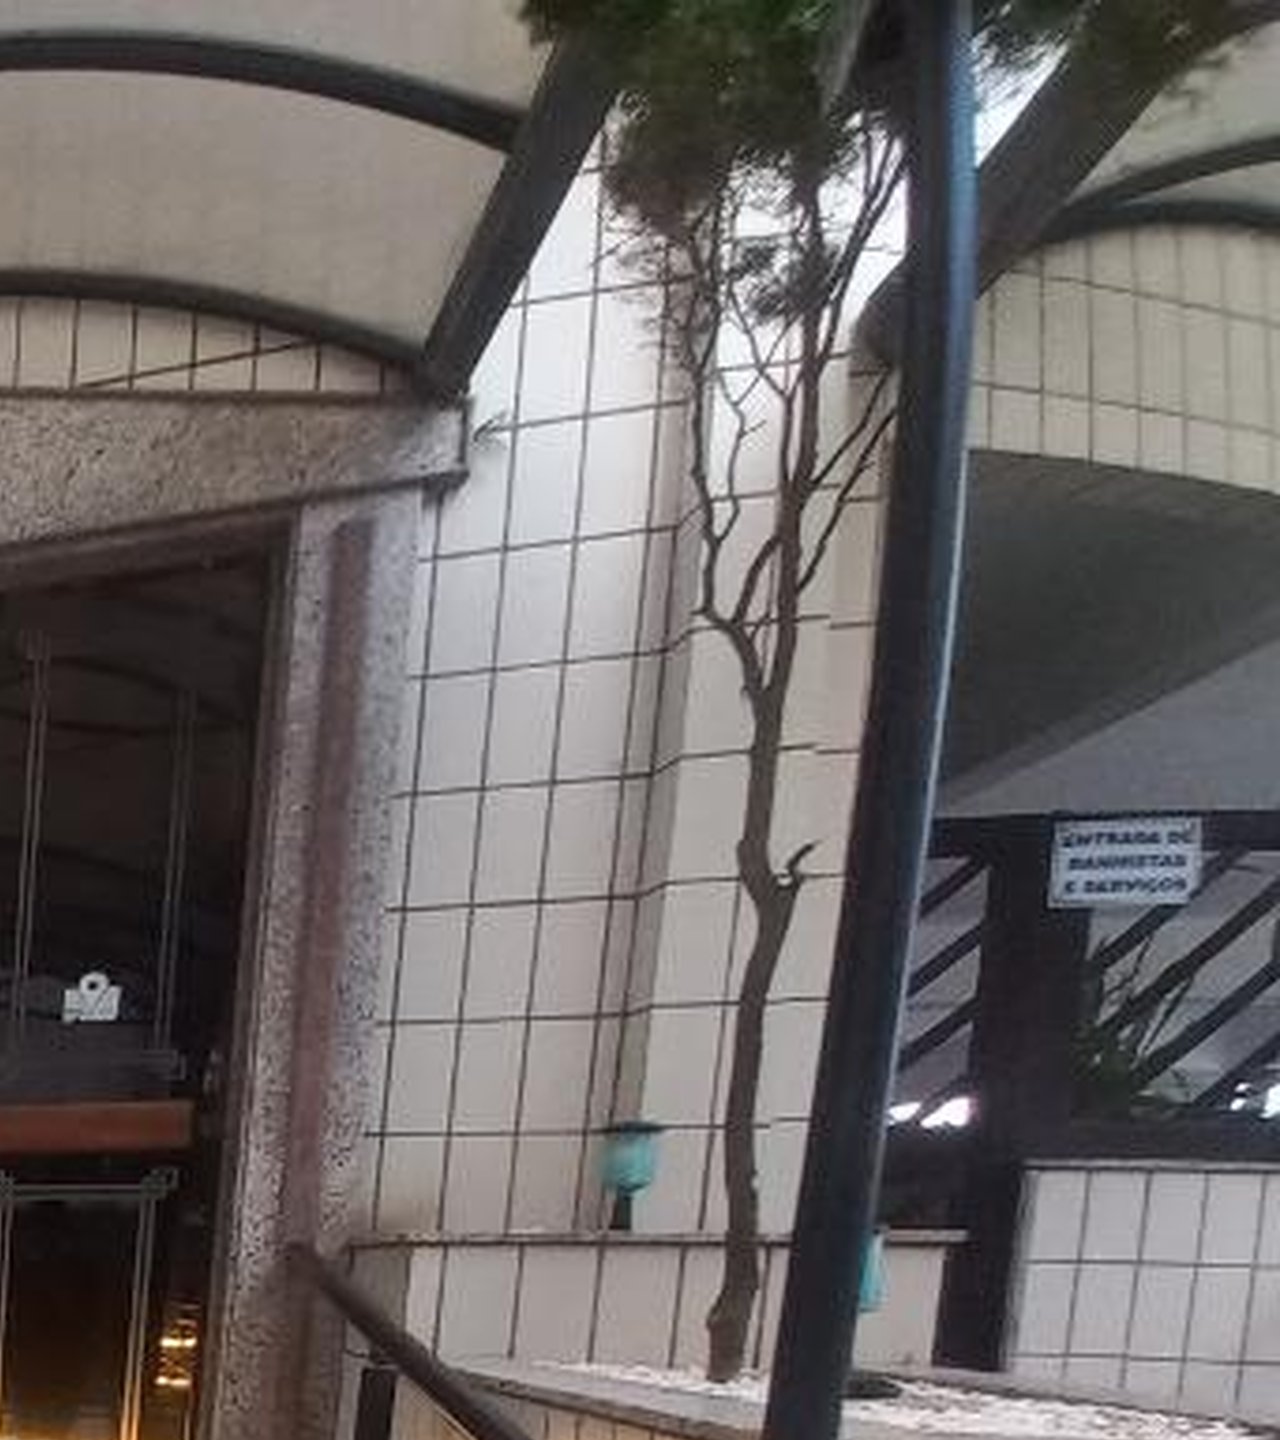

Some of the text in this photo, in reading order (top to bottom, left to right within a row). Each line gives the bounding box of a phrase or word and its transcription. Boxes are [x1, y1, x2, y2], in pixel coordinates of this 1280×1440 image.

[1061, 829, 1194, 847] ENTRADA DE
[1084, 877, 1188, 895] SERVIÇOS
